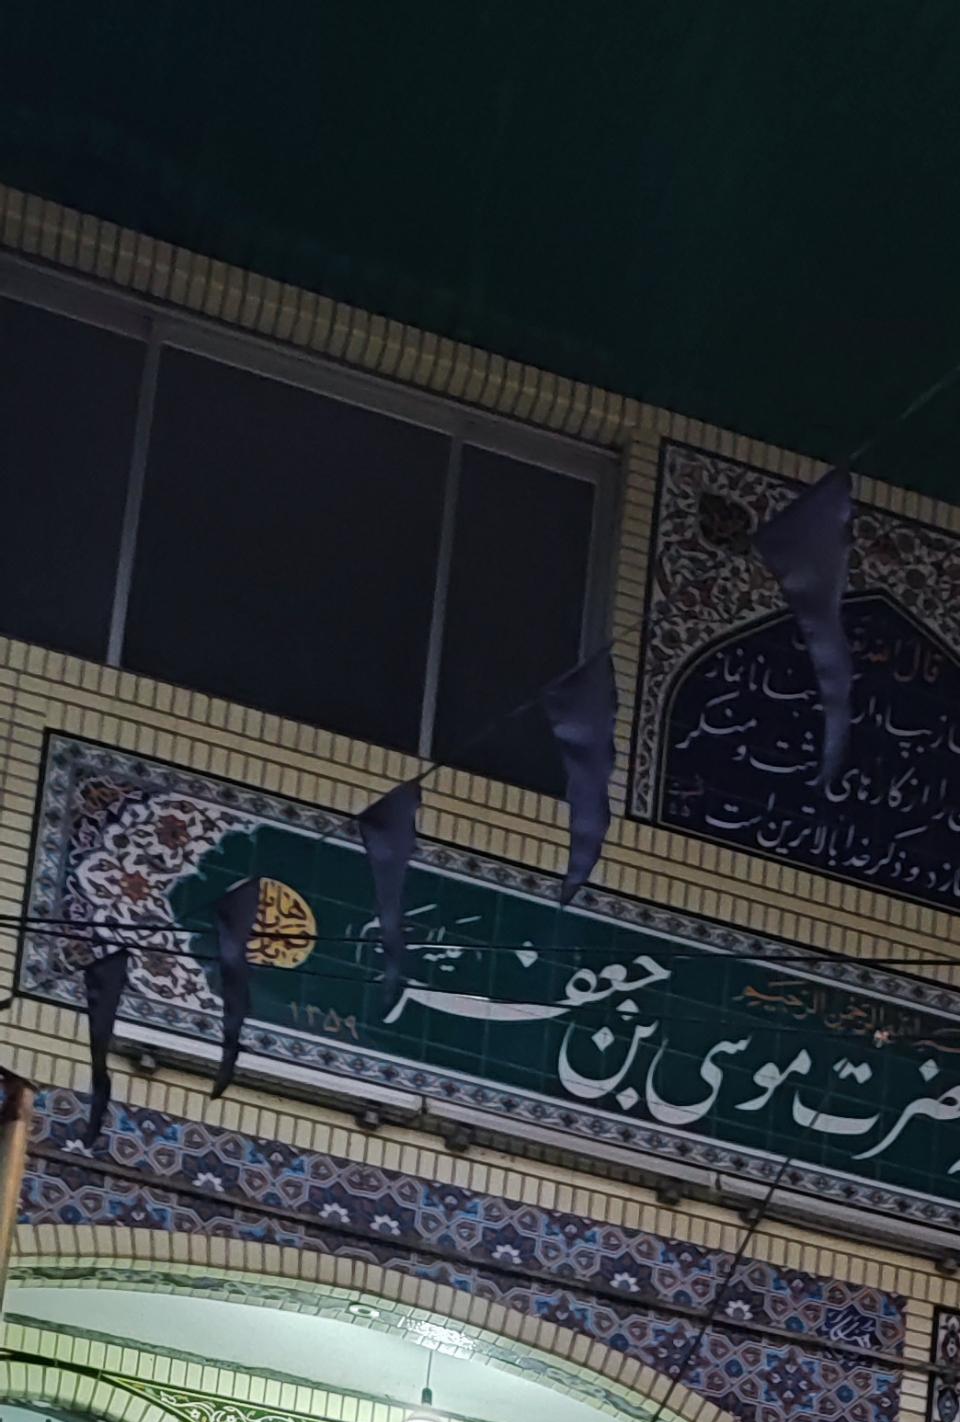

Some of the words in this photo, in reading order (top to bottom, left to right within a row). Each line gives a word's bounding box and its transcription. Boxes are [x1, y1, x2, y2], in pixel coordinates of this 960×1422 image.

[382, 941, 672, 1024] جعفر
[558, 1018, 660, 1111] بن
[645, 1034, 812, 1126] موسی
